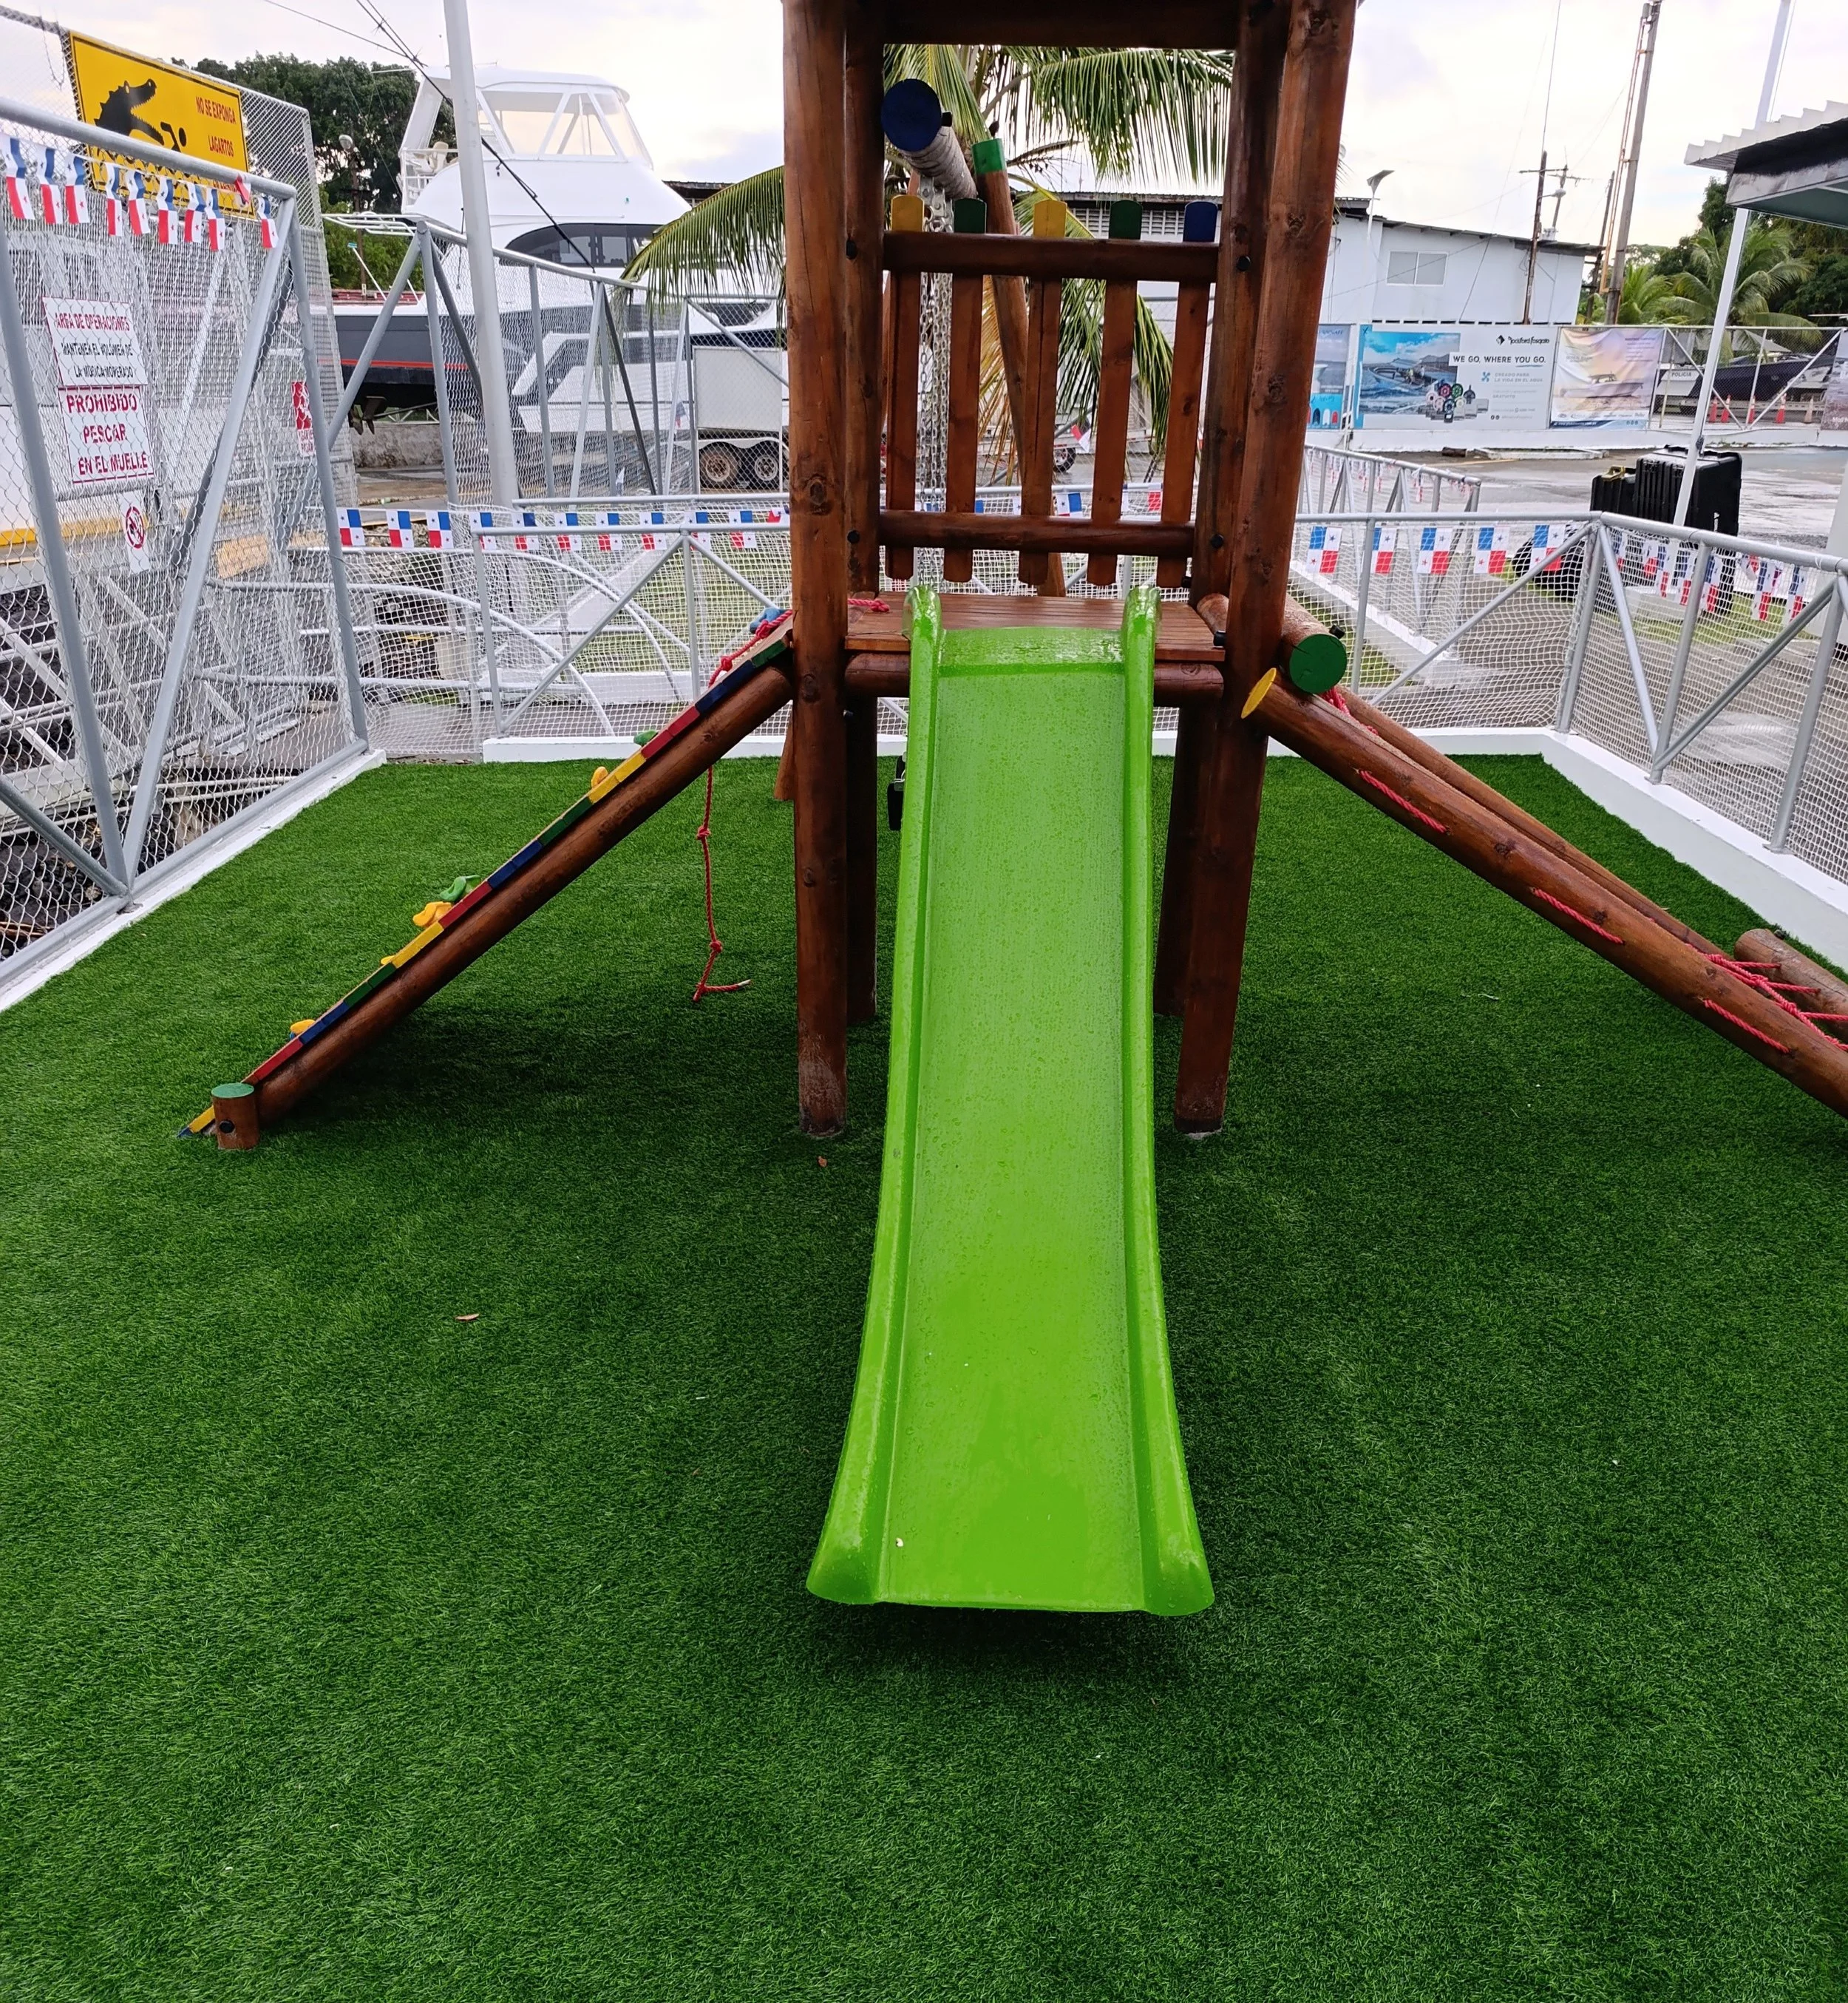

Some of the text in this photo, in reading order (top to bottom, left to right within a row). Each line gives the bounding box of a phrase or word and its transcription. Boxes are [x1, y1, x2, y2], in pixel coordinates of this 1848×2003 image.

[195, 96, 237, 125] NO SE EXPONGA
[208, 135, 234, 158] LAGARTOS
[74, 314, 85, 329] DE
[85, 314, 130, 331] OPERACIONES
[92, 342, 101, 356] EL
[1468, 356, 1481, 364] GO,
[66, 393, 137, 413] PROHIBIDO
[83, 423, 128, 444] PESCAR
[78, 451, 148, 475] EN EL MUELLE
